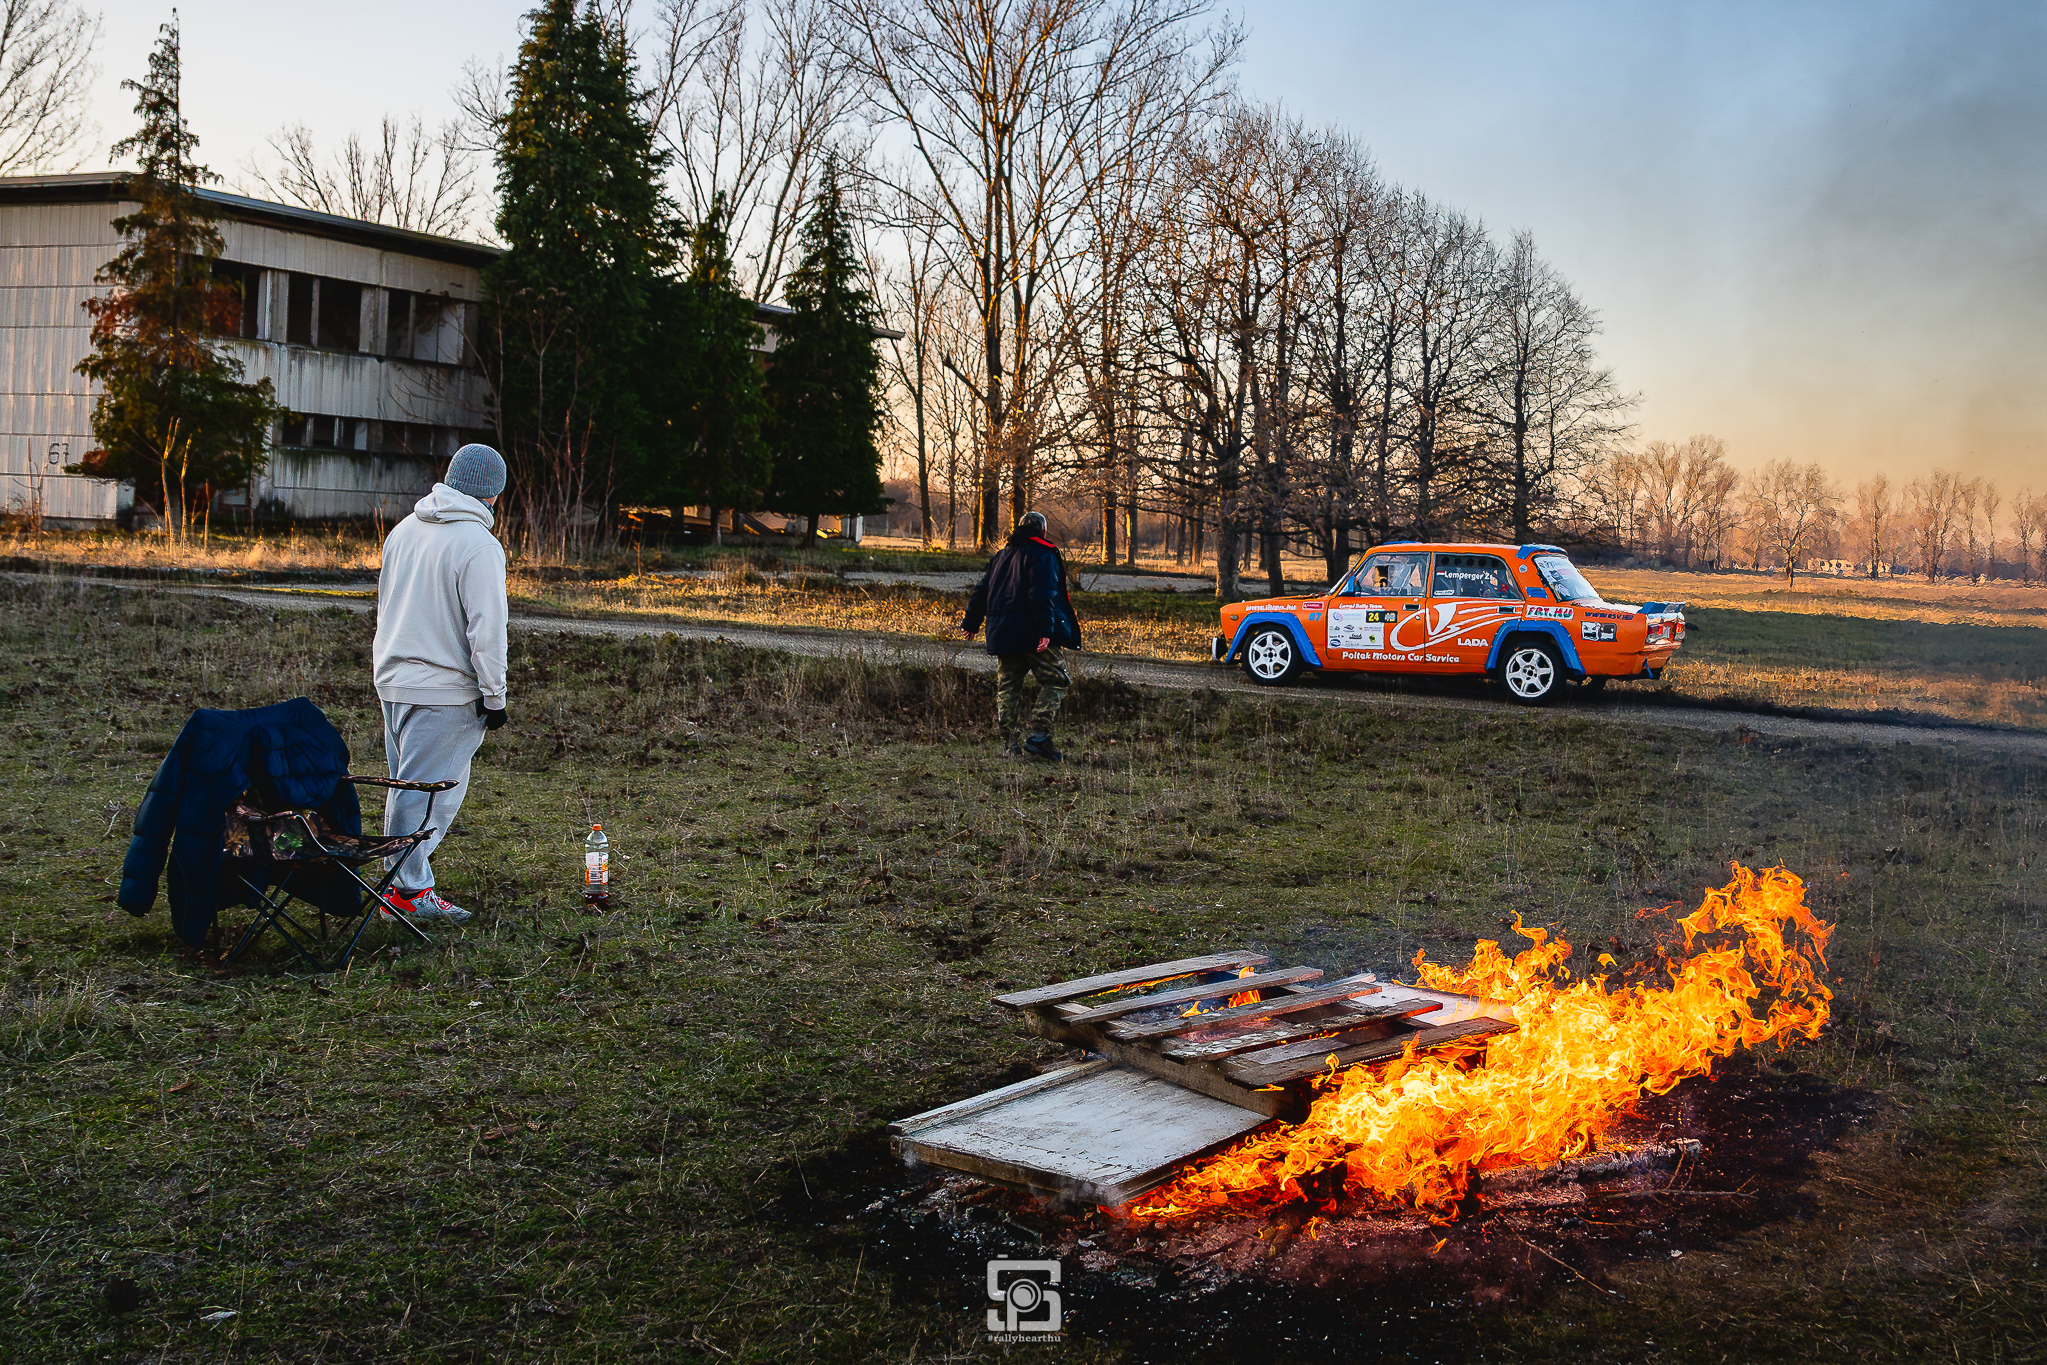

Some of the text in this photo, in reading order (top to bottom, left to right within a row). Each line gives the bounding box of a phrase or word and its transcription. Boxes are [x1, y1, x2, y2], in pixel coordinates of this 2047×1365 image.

[49, 442, 69, 466] 67
[1368, 612, 1380, 622] 24
[1457, 637, 1489, 648] LADA
[1372, 651, 1406, 661] Motors
[1407, 652, 1424, 662] Car
[1425, 653, 1460, 663] Service
